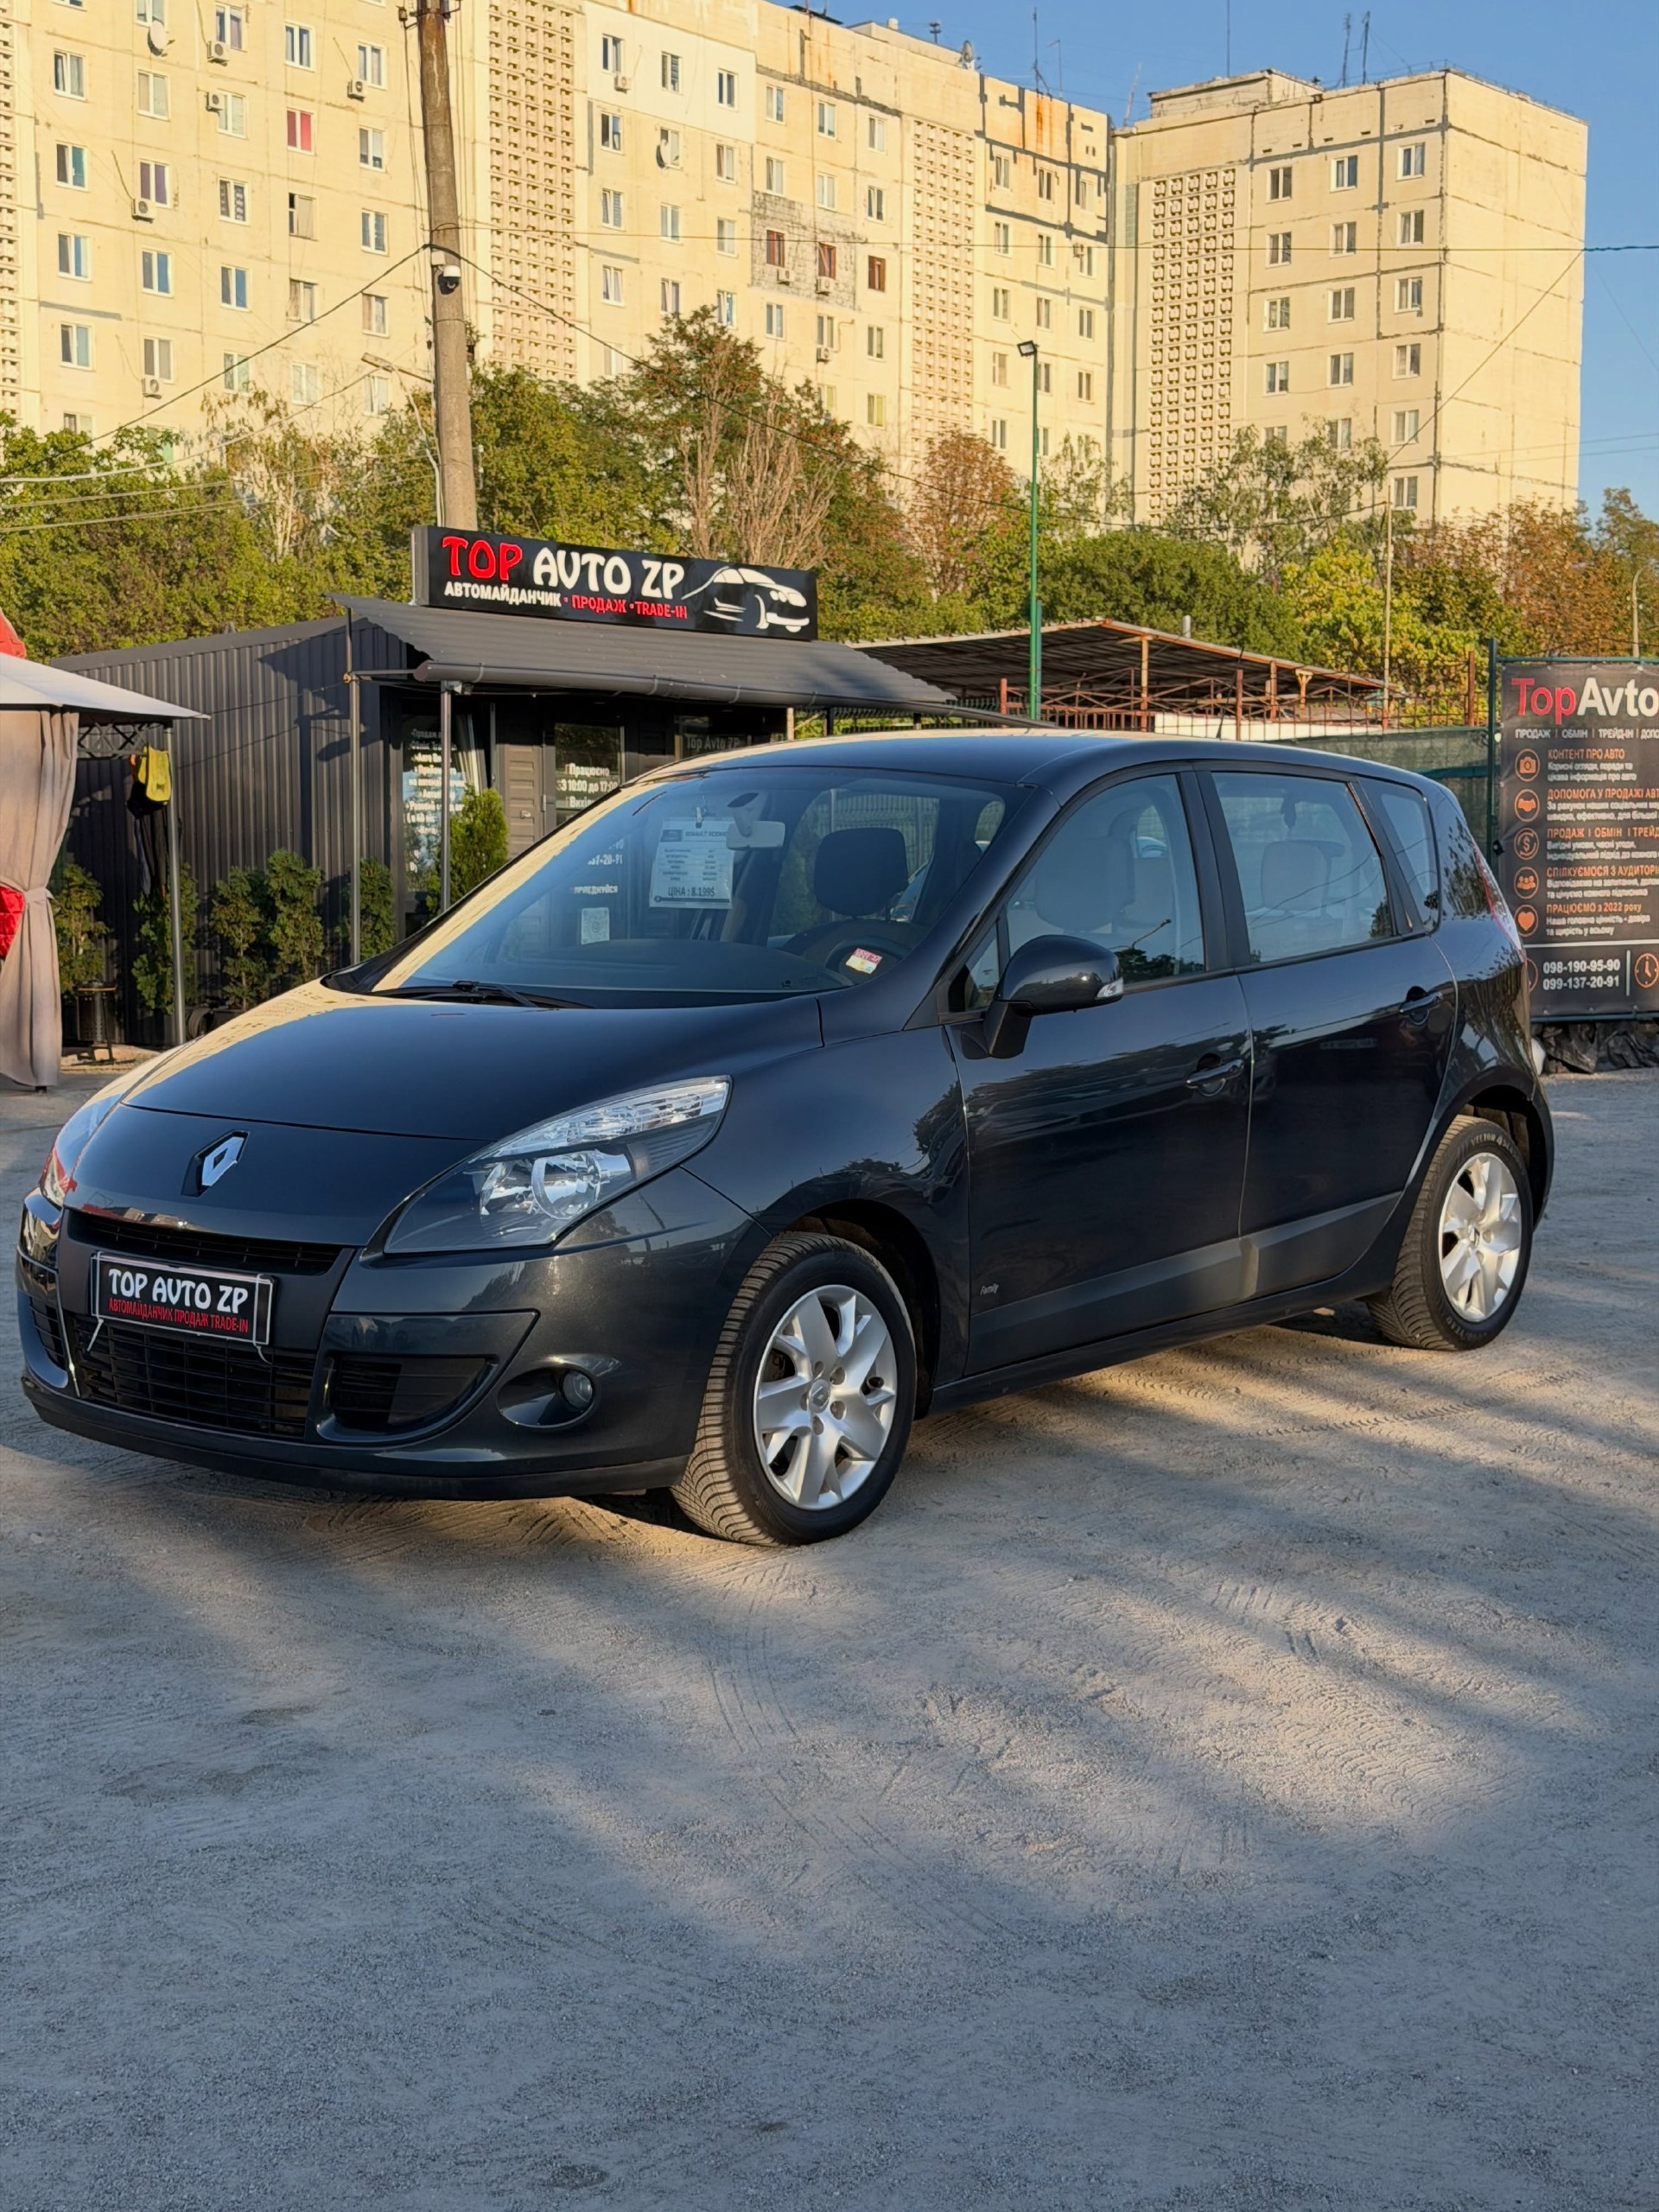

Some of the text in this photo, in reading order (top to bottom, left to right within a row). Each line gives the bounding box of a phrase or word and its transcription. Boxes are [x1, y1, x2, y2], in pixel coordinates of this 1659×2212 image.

[442, 535, 523, 581] TOP
[641, 560, 684, 599] ZP
[444, 581, 687, 619] АВТОМАЙДАНЧИК ПРОДАЖ TRADE-IN
[1515, 729, 1551, 739] ПРОДАЖ
[1561, 729, 1588, 739] ОБМІН
[684, 733, 702, 751] Top
[1548, 748, 1625, 760] КОНТЕНТ ПРО АВТО
[569, 762, 610, 778] Працюємо
[568, 779, 588, 791] 10:00
[1548, 788, 1596, 800] ДОПОМОГА
[1605, 788, 1644, 800] ПРОДАЖІ
[1548, 828, 1584, 839] ПРОДАЖ
[1594, 827, 1622, 838] ОБМІН
[1547, 866, 1609, 878] СПІЛКУЄМОСЯ
[1547, 903, 1596, 915] ПРАЦЮЄМО
[1624, 903, 1642, 914] року
[1542, 958, 1621, 974] 098-190-95-90
[1542, 975, 1619, 990] 099-137-20-91
[108, 1268, 148, 1299] TOP
[217, 1285, 248, 1314] ZP
[108, 1298, 248, 1333] АВТОМАЙДАНЧИК ПРОДАЖ TRADE-IN
